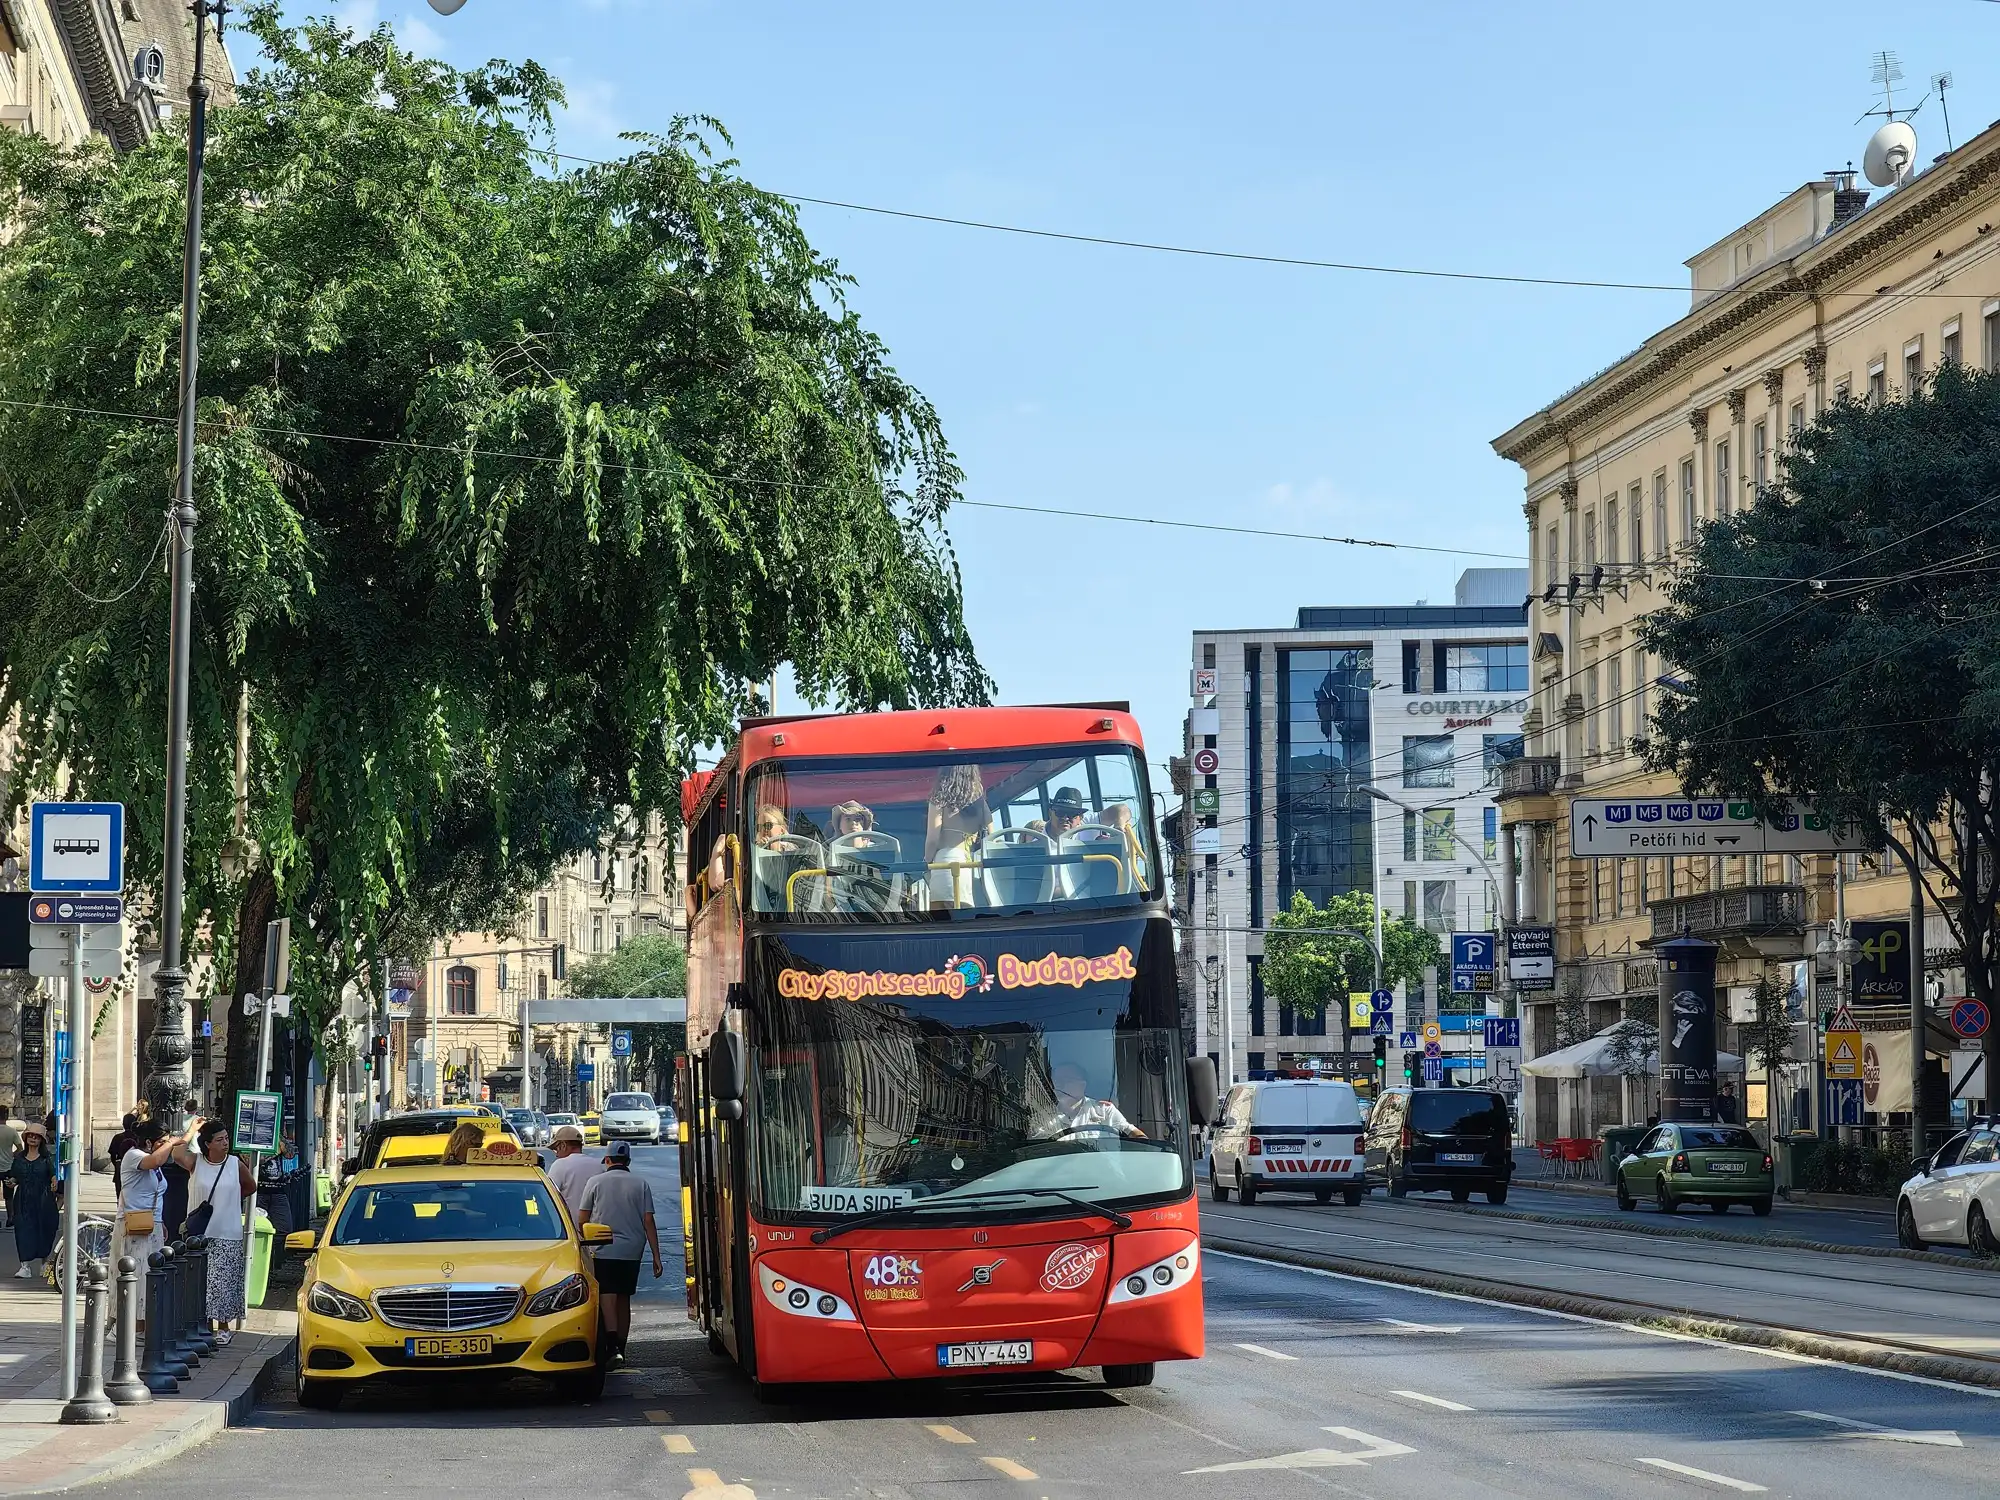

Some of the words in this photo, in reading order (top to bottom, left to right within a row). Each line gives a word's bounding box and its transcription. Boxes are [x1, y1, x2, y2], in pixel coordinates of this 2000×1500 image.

[1201, 680, 1211, 688] M
[1406, 699, 1529, 715] COURTYARD
[1443, 716, 1493, 729] Marriott
[1199, 754, 1214, 768] e
[1610, 807, 1627, 820] M1
[1640, 806, 1659, 819] M5
[1670, 806, 1689, 818] M6
[1701, 805, 1720, 818] M7
[1737, 805, 1746, 817] 4
[1813, 816, 1821, 828] 3
[37, 907, 49, 915] A2
[1467, 943, 1483, 962] P
[1512, 940, 1549, 950] Étterem
[998, 944, 1137, 990] Budapest
[1860, 978, 1904, 993] ÁRKÁD
[1336, 1060, 1359, 1070] CFÉ
[1684, 1066, 1711, 1080] ÉVA
[810, 1194, 859, 1212] BUDA
[862, 1195, 903, 1212] SIDE
[864, 1255, 899, 1286] 48
[1046, 1248, 1102, 1286] OFFICIAL
[1068, 1267, 1093, 1285] TOUR
[864, 1287, 888, 1300] Valid
[890, 1287, 919, 1300] Ticket
[417, 1338, 488, 1354] EDE-350
[951, 1343, 1027, 1363] PNY-449
